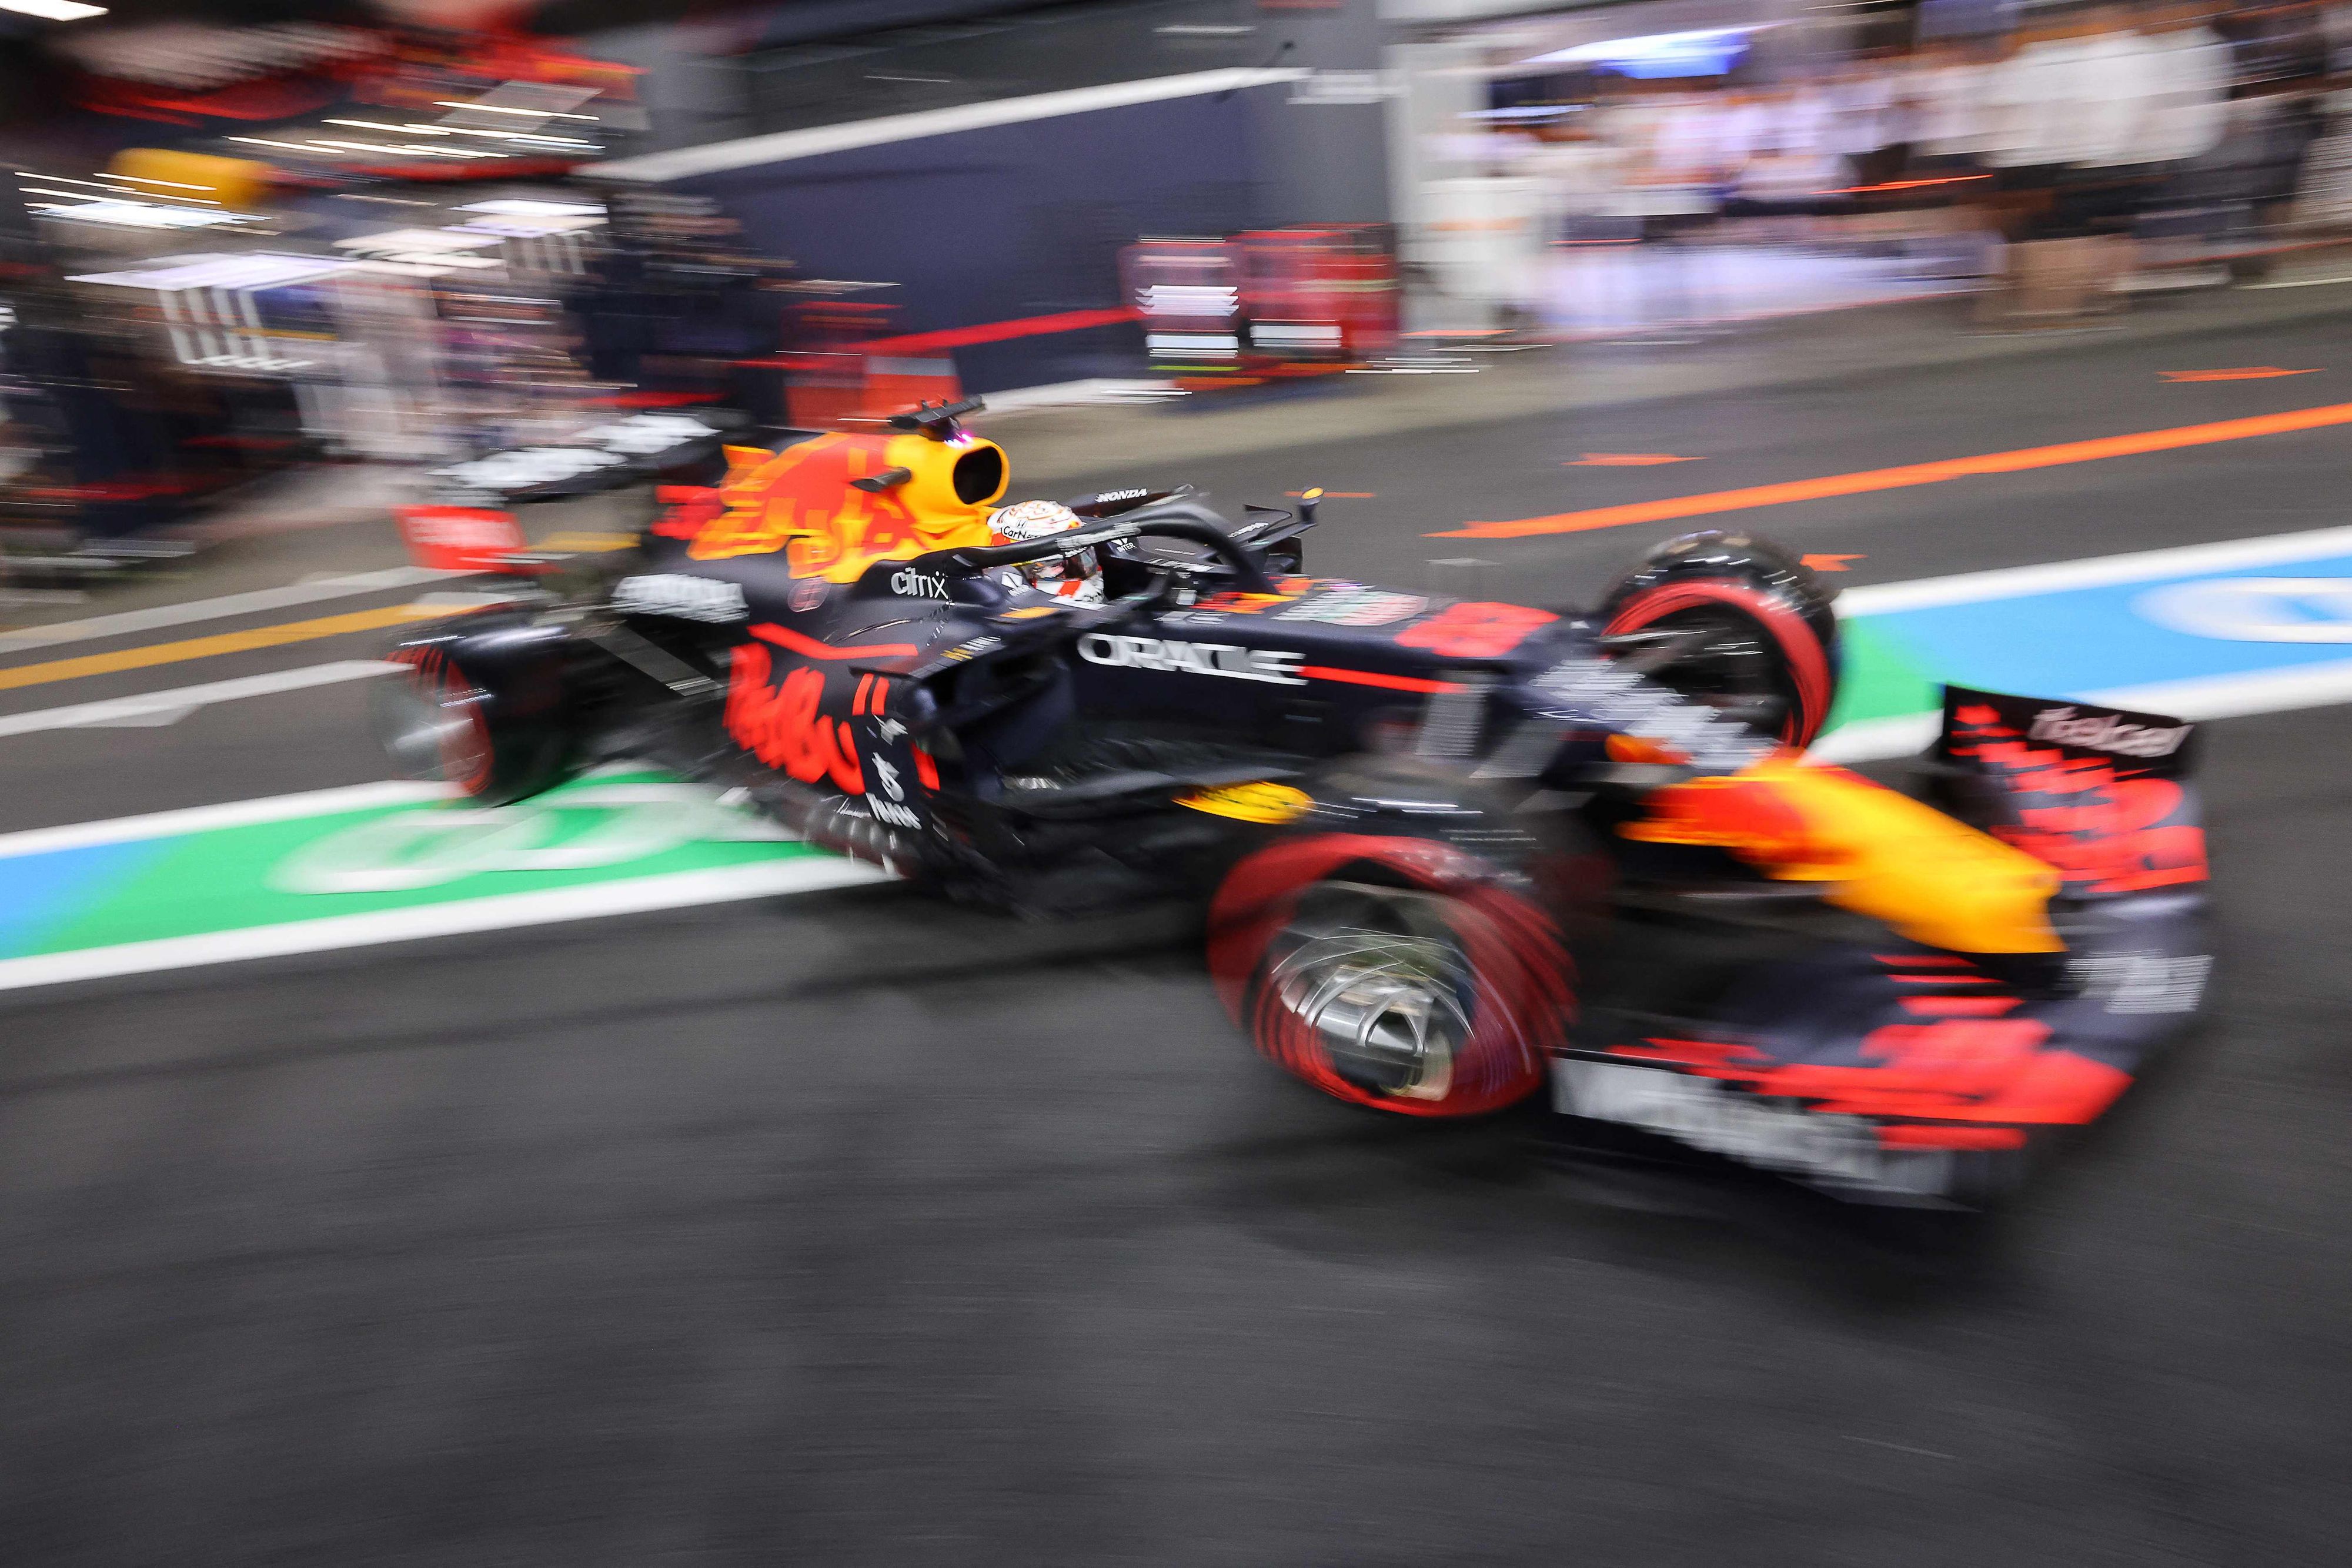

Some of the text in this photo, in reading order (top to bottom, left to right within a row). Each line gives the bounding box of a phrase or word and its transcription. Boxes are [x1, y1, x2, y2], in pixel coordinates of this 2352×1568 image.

[1095, 488, 1147, 503] HONDA
[891, 567, 948, 600] citrix
[1077, 633, 1309, 686] ORACLE
